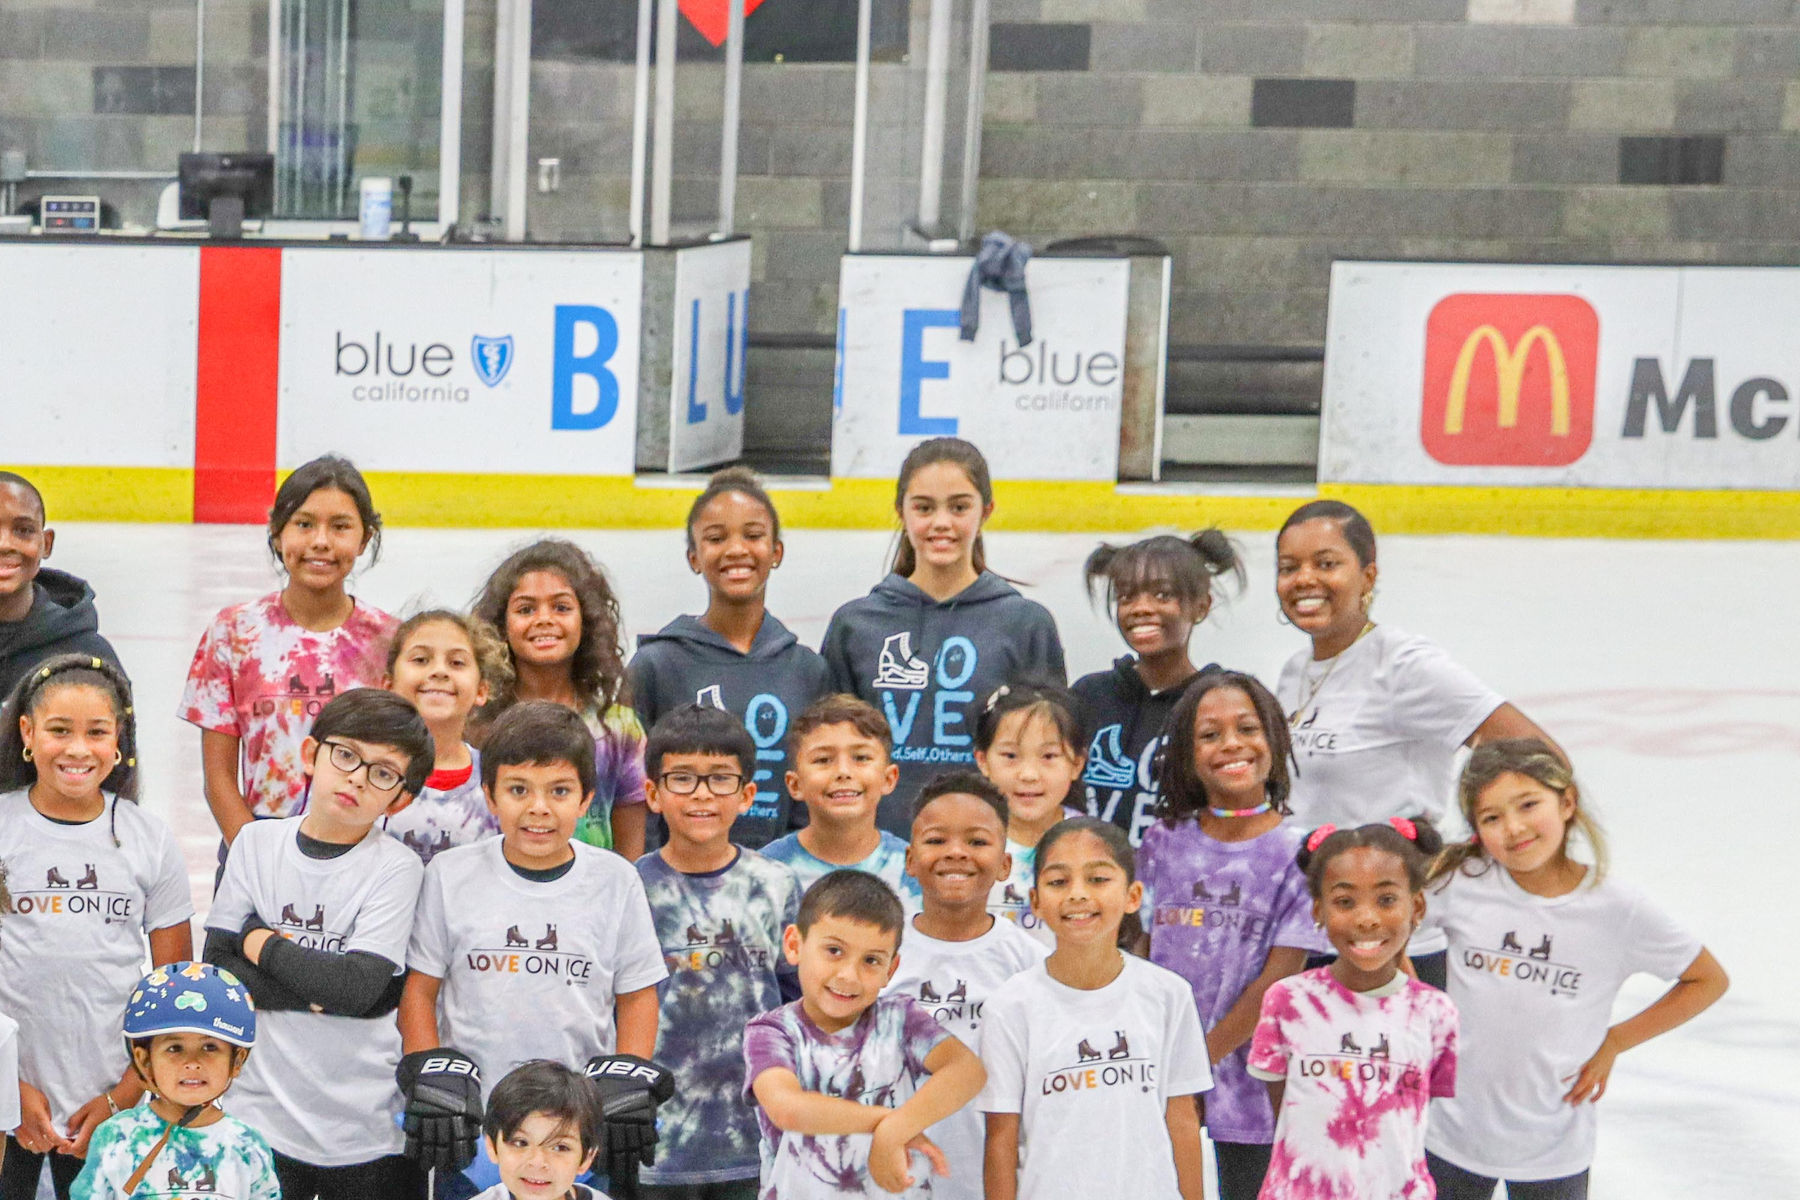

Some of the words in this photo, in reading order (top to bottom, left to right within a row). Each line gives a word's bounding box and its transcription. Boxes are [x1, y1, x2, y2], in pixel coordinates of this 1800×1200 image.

[335, 330, 454, 378] blue
[999, 338, 1118, 387] blue
[352, 381, 470, 403] california
[1620, 357, 1800, 441] Mc
[252, 698, 303, 717] LOVE
[882, 690, 975, 746] VE
[9, 895, 63, 914] LOVE
[67, 895, 101, 914] ON
[106, 896, 131, 917] ICE
[1155, 907, 1205, 927] LOVE
[467, 953, 520, 973] LOVE
[525, 955, 560, 975] ON
[565, 958, 594, 979] ICE
[1463, 949, 1511, 976] LOVE
[1514, 961, 1548, 984] ON
[1552, 967, 1584, 990] ICE
[1042, 1070, 1098, 1095] LOVE
[1101, 1066, 1134, 1086] ON
[1300, 1059, 1355, 1081] LOVE
[1359, 1062, 1391, 1082] ON
